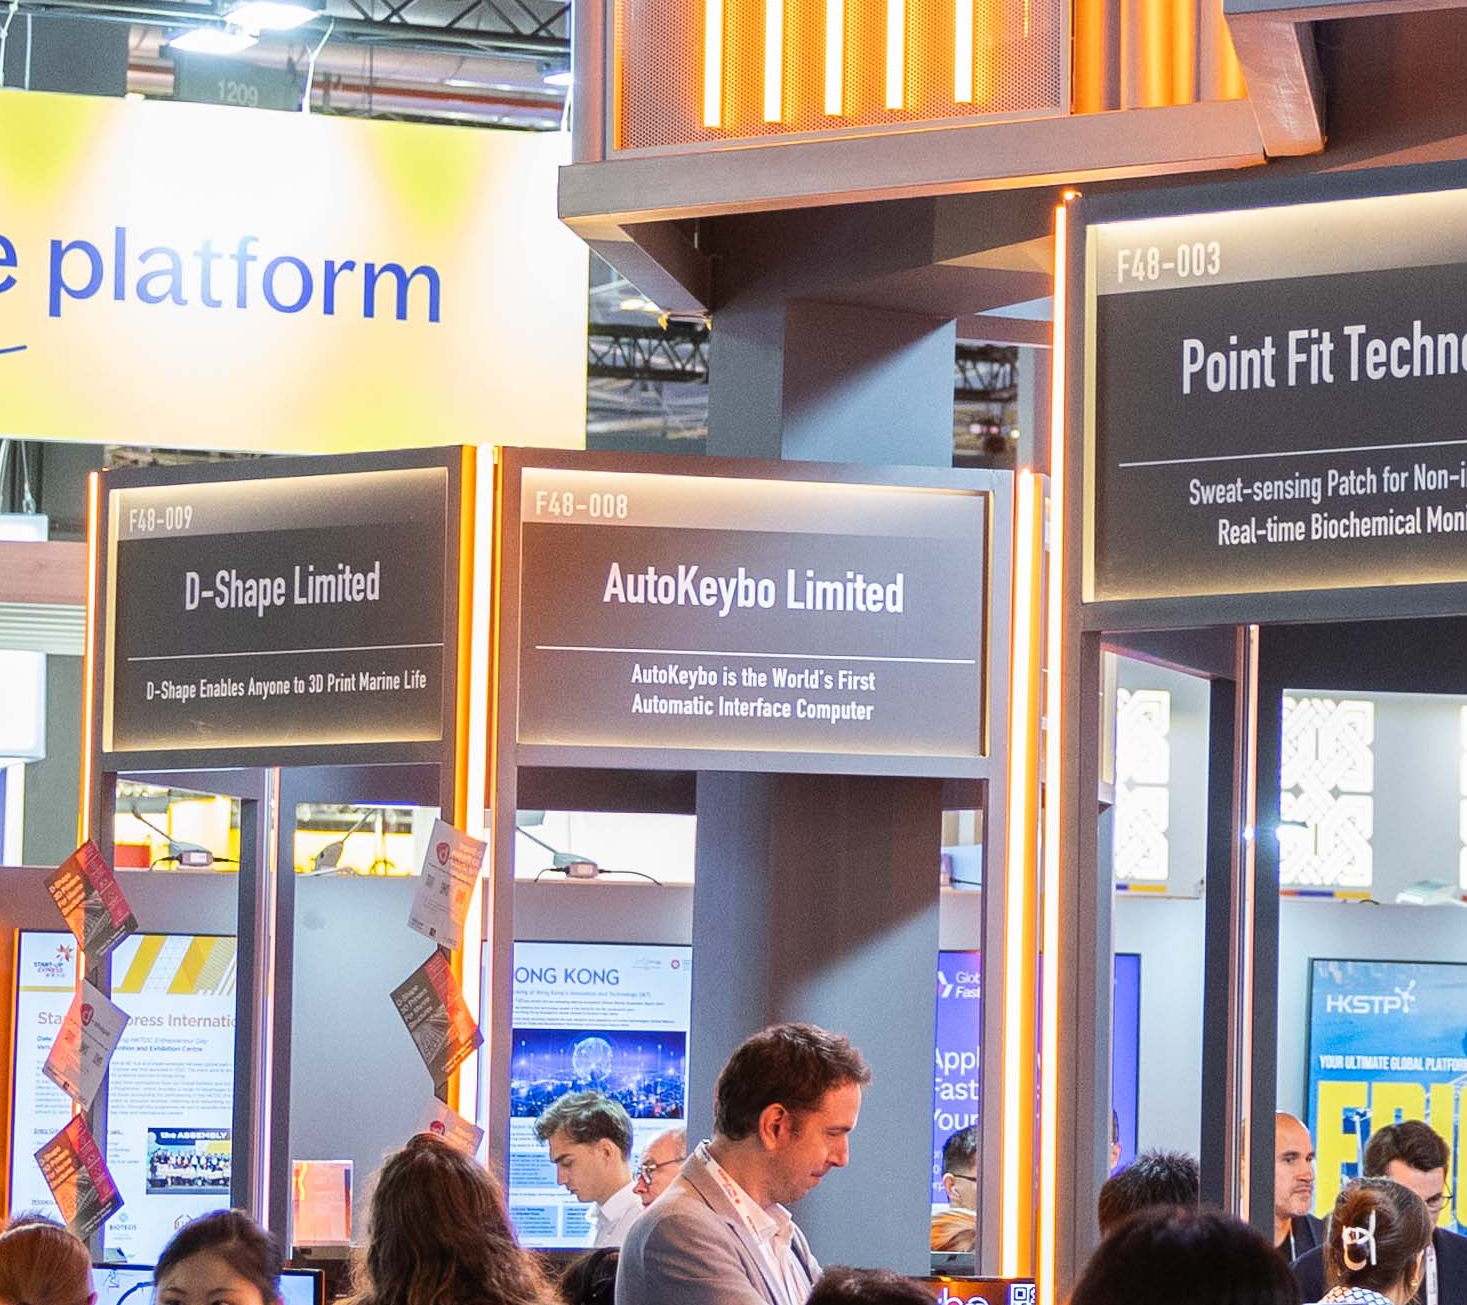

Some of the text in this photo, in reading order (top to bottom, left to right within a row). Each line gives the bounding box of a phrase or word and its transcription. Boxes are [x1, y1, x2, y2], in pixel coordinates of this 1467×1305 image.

[218, 79, 258, 106] 1209
[47, 225, 441, 324] platform
[1117, 242, 1221, 284] F48-003
[1182, 336, 1275, 395] Point
[1288, 328, 1334, 386] Fit
[1189, 475, 1323, 507] Sweat-sensing
[1327, 469, 1379, 499] Patch
[1382, 466, 1409, 495] for
[129, 506, 192, 533] F48-009
[536, 491, 628, 519] F48-008
[1218, 514, 1306, 546] Real-time
[1311, 508, 1422, 542] Biochemical
[186, 561, 380, 617] D-Shape Limited
[603, 562, 905, 617] AutoKeybo Limited
[147, 670, 427, 704] D-Shape Enables Anyone to 3D Print Marine Life
[631, 663, 876, 691] AutoKeybo is the World's First
[631, 693, 874, 724] Automatic Interface Computer
[515, 967, 619, 985] ONG KONG
[1320, 1055, 1344, 1069] YOUR
[1345, 1056, 1389, 1070] ULTIMATE
[1390, 1057, 1423, 1071] GLOBAL
